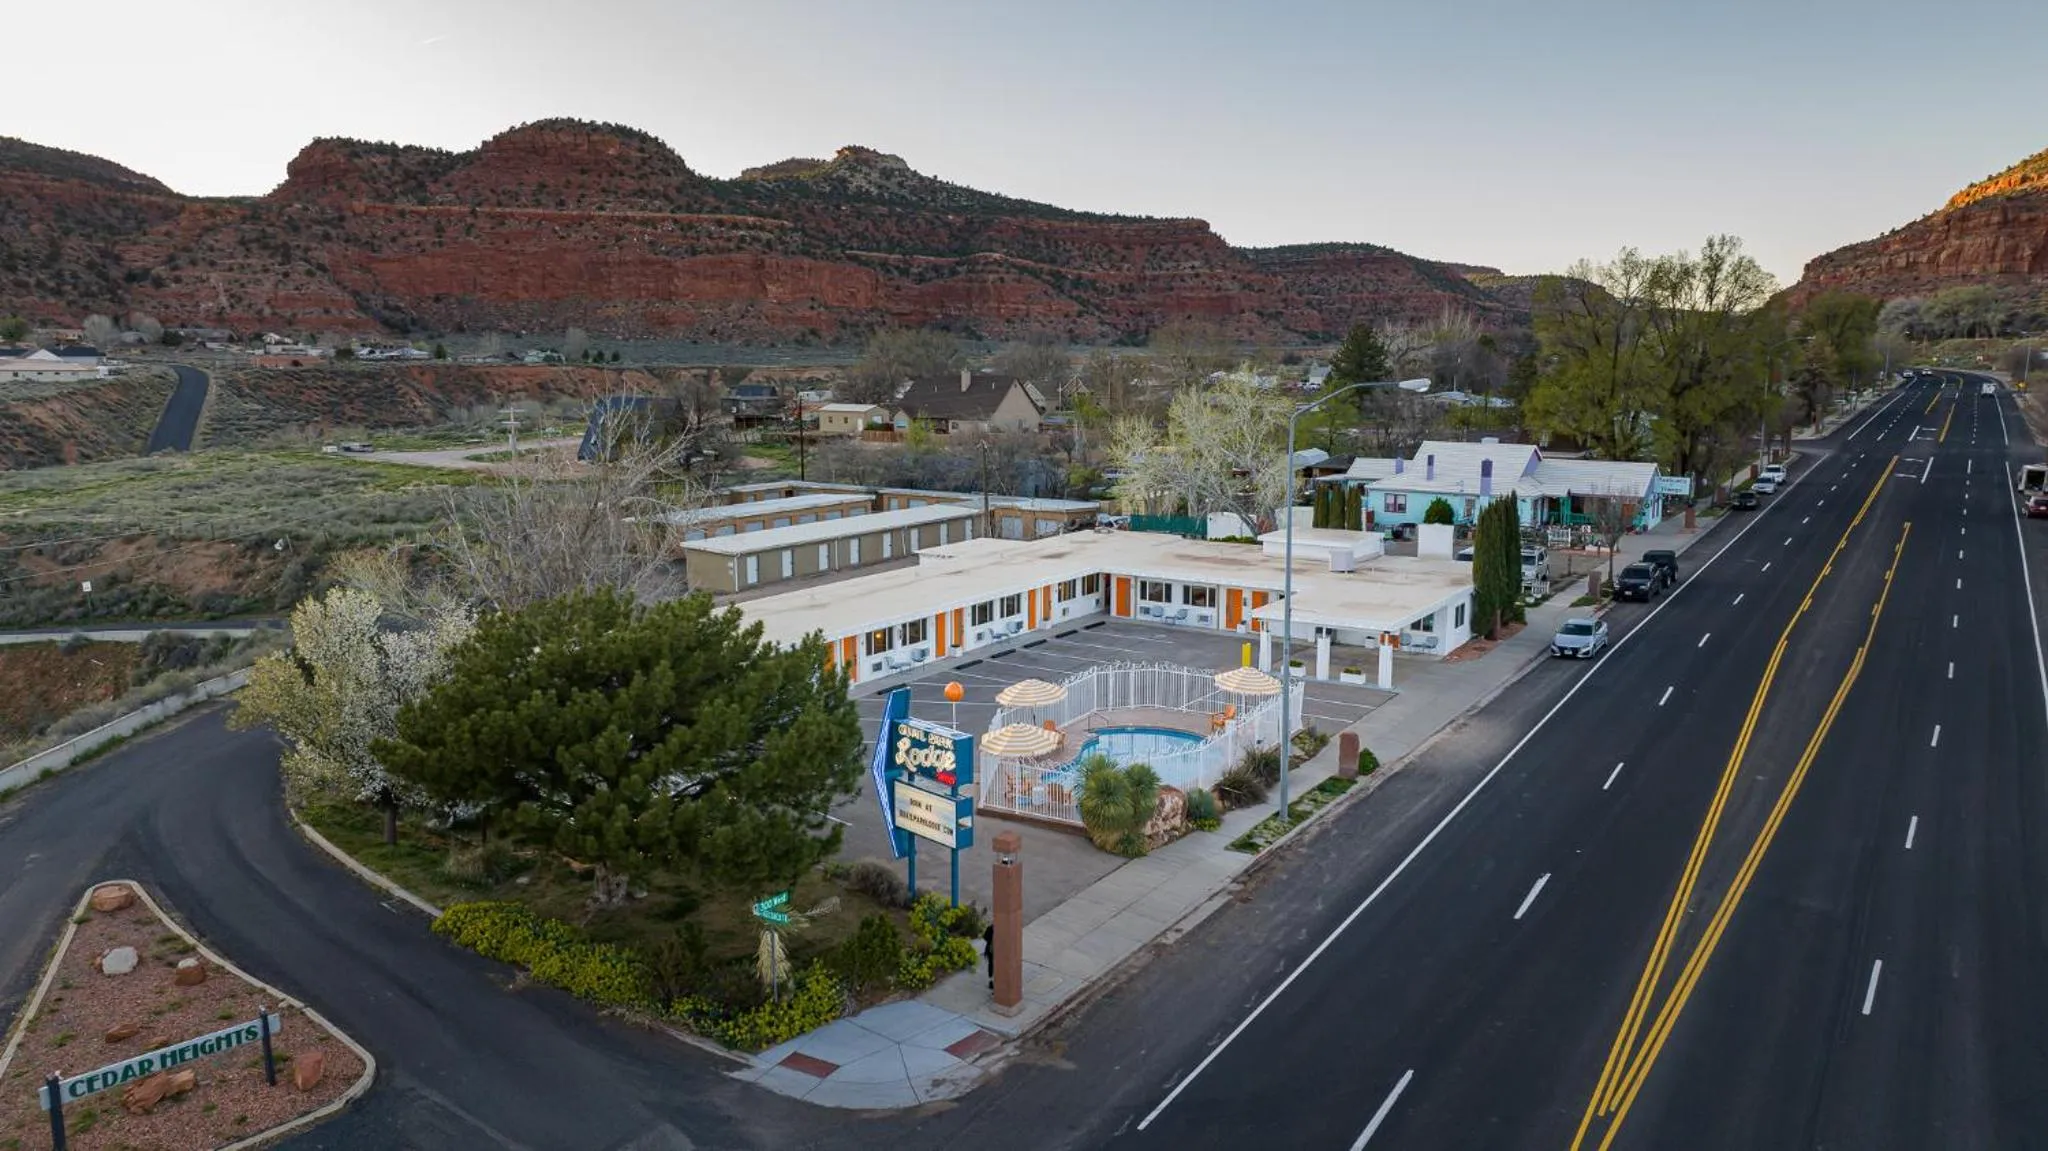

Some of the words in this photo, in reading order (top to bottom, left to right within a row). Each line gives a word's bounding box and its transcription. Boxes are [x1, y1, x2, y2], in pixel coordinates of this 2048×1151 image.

[895, 737, 956, 773] Lodge
[68, 1058, 154, 1098] CEDAR
[160, 1024, 259, 1069] HEIGHTS
